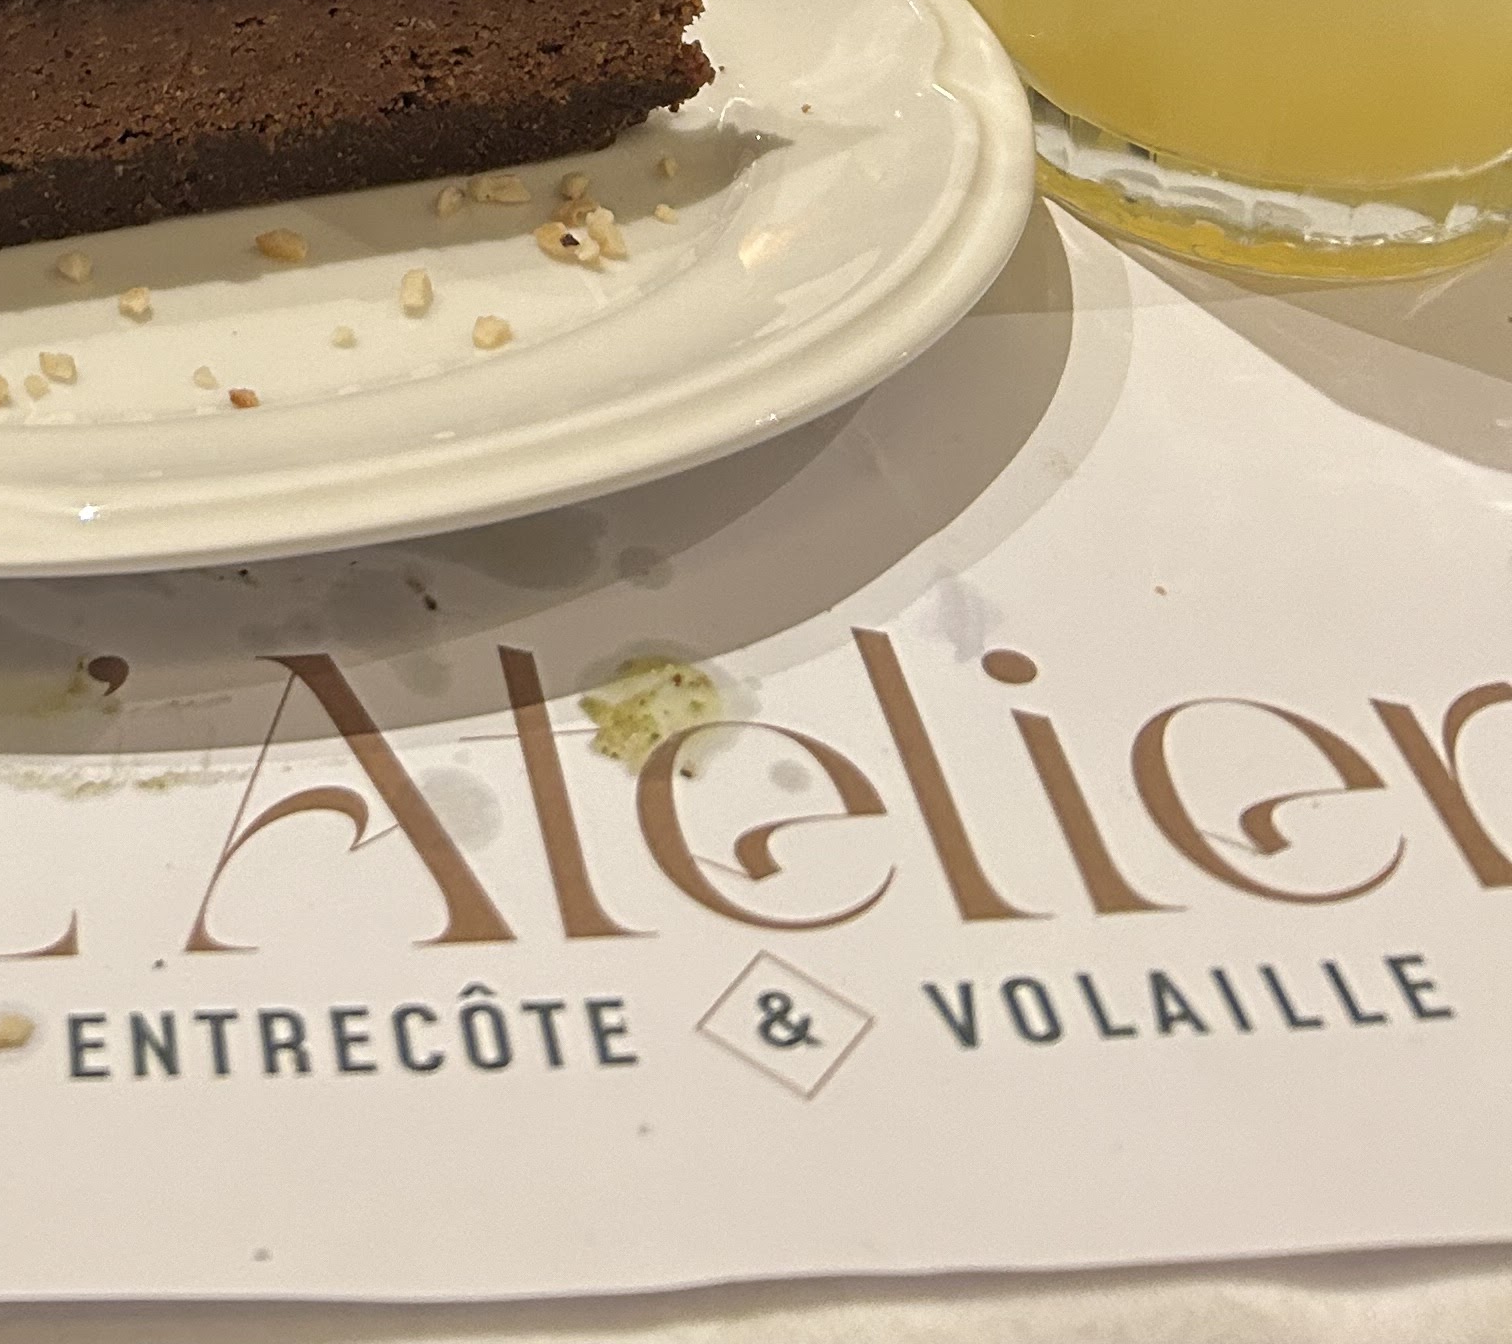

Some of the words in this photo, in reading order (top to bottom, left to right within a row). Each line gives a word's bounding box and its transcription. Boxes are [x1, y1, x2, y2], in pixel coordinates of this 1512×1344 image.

[66, 984, 641, 1082] ENTRECÔTE
[752, 988, 824, 1050] &
[923, 952, 1458, 1050] VOLAILLE
